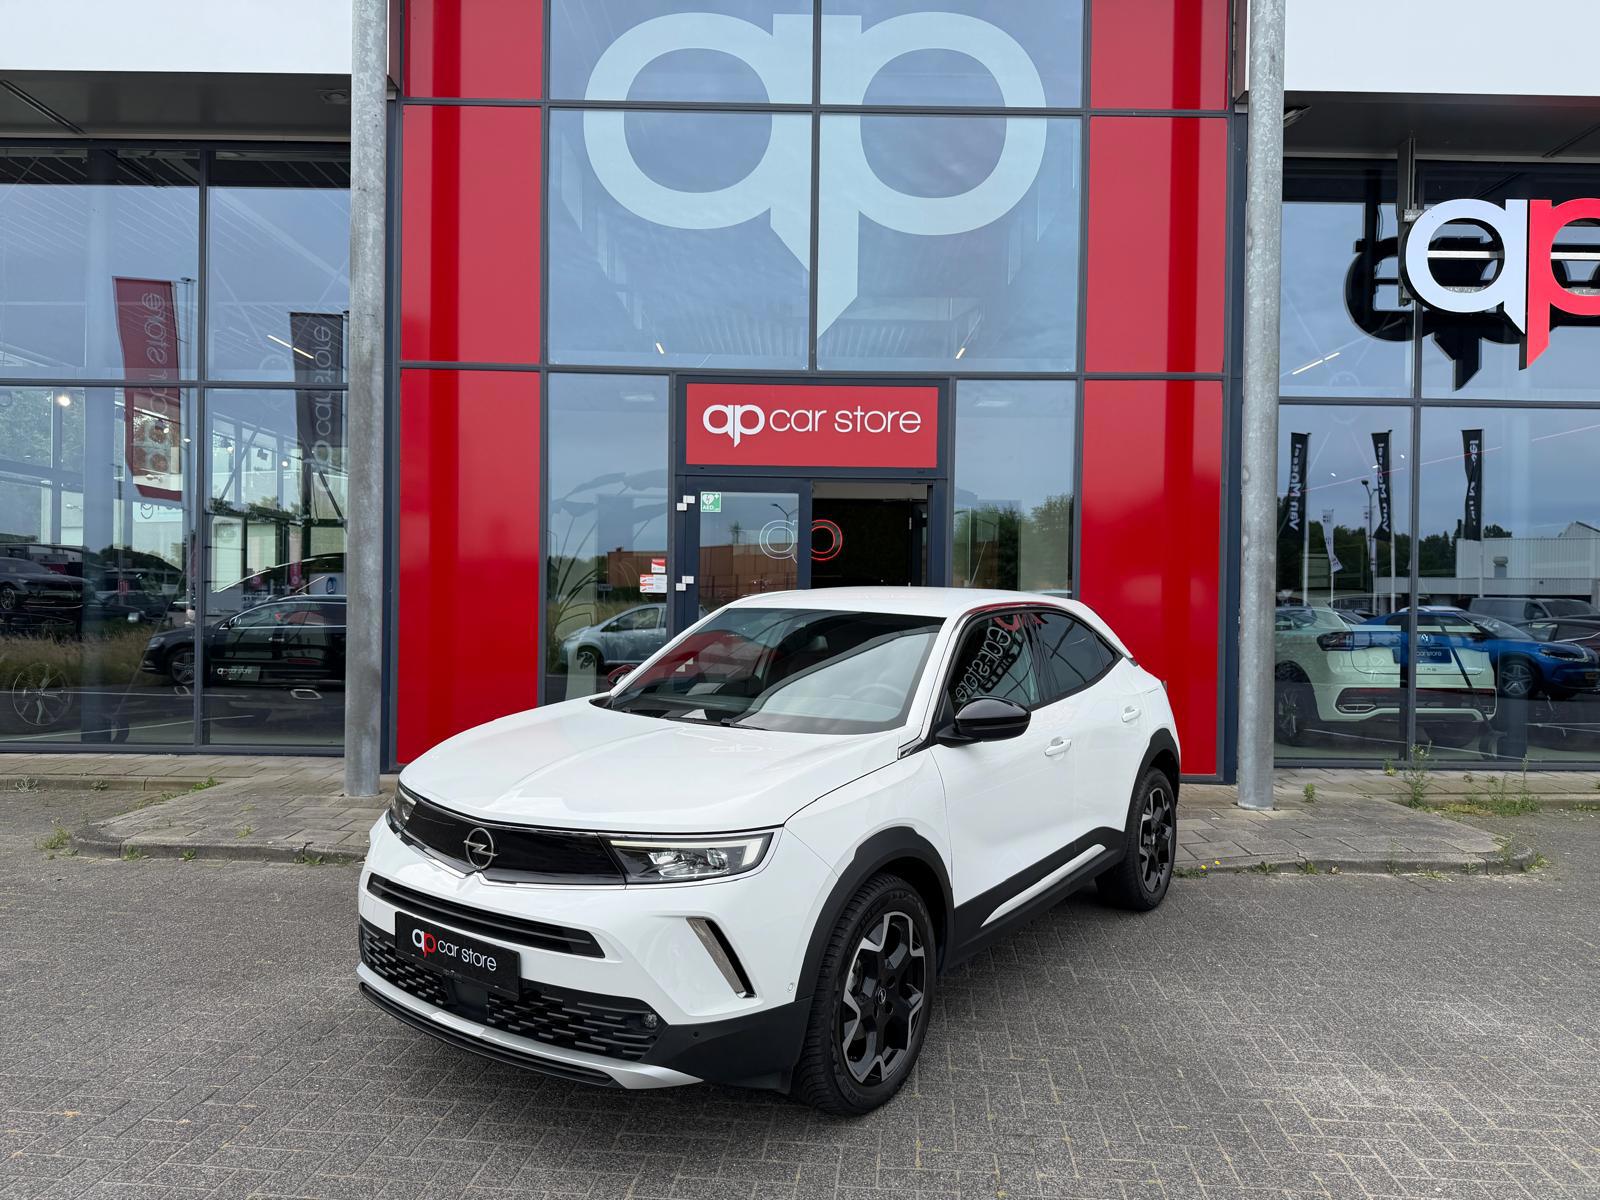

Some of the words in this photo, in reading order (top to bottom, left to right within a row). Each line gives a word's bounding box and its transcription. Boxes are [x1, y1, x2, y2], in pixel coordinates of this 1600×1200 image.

[583, 11, 1047, 339] ap
[703, 404, 765, 448] ap
[769, 409, 827, 432] car
[834, 405, 921, 433] store
[412, 928, 437, 958] ap
[437, 940, 459, 957] car
[461, 948, 497, 971] store
